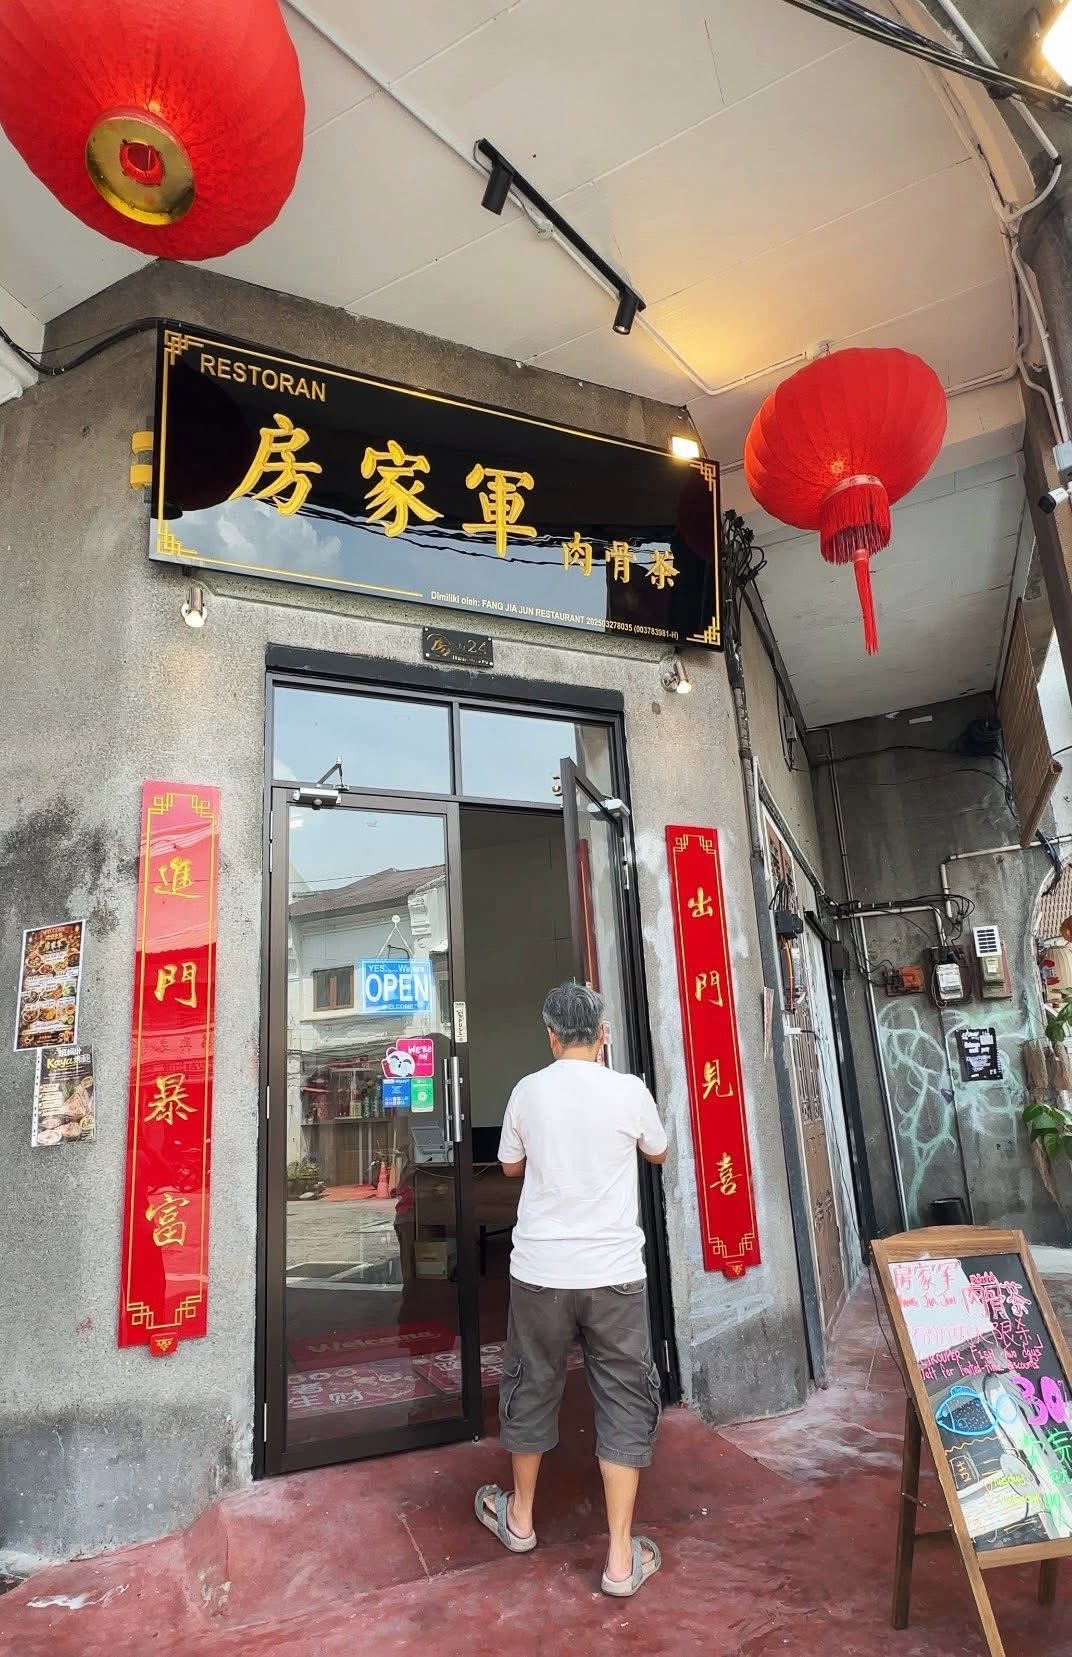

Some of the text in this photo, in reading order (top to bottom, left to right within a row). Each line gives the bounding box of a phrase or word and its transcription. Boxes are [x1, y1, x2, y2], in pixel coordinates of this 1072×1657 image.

[200, 353, 327, 403] RESTORAN
[228, 413, 537, 559] 房家軍
[562, 531, 680, 590] 肉骨茶
[431, 591, 460, 605] Dimiliki
[461, 597, 480, 608] oleh:
[482, 600, 504, 611] FANG
[505, 603, 517, 614] JIA
[519, 606, 534, 616] JUN
[535, 608, 584, 624] RESTAURANT
[365, 973, 429, 1003] OPEN
[47, 1057, 73, 1069] Kaya
[687, 886, 743, 1197] 出門見喜
